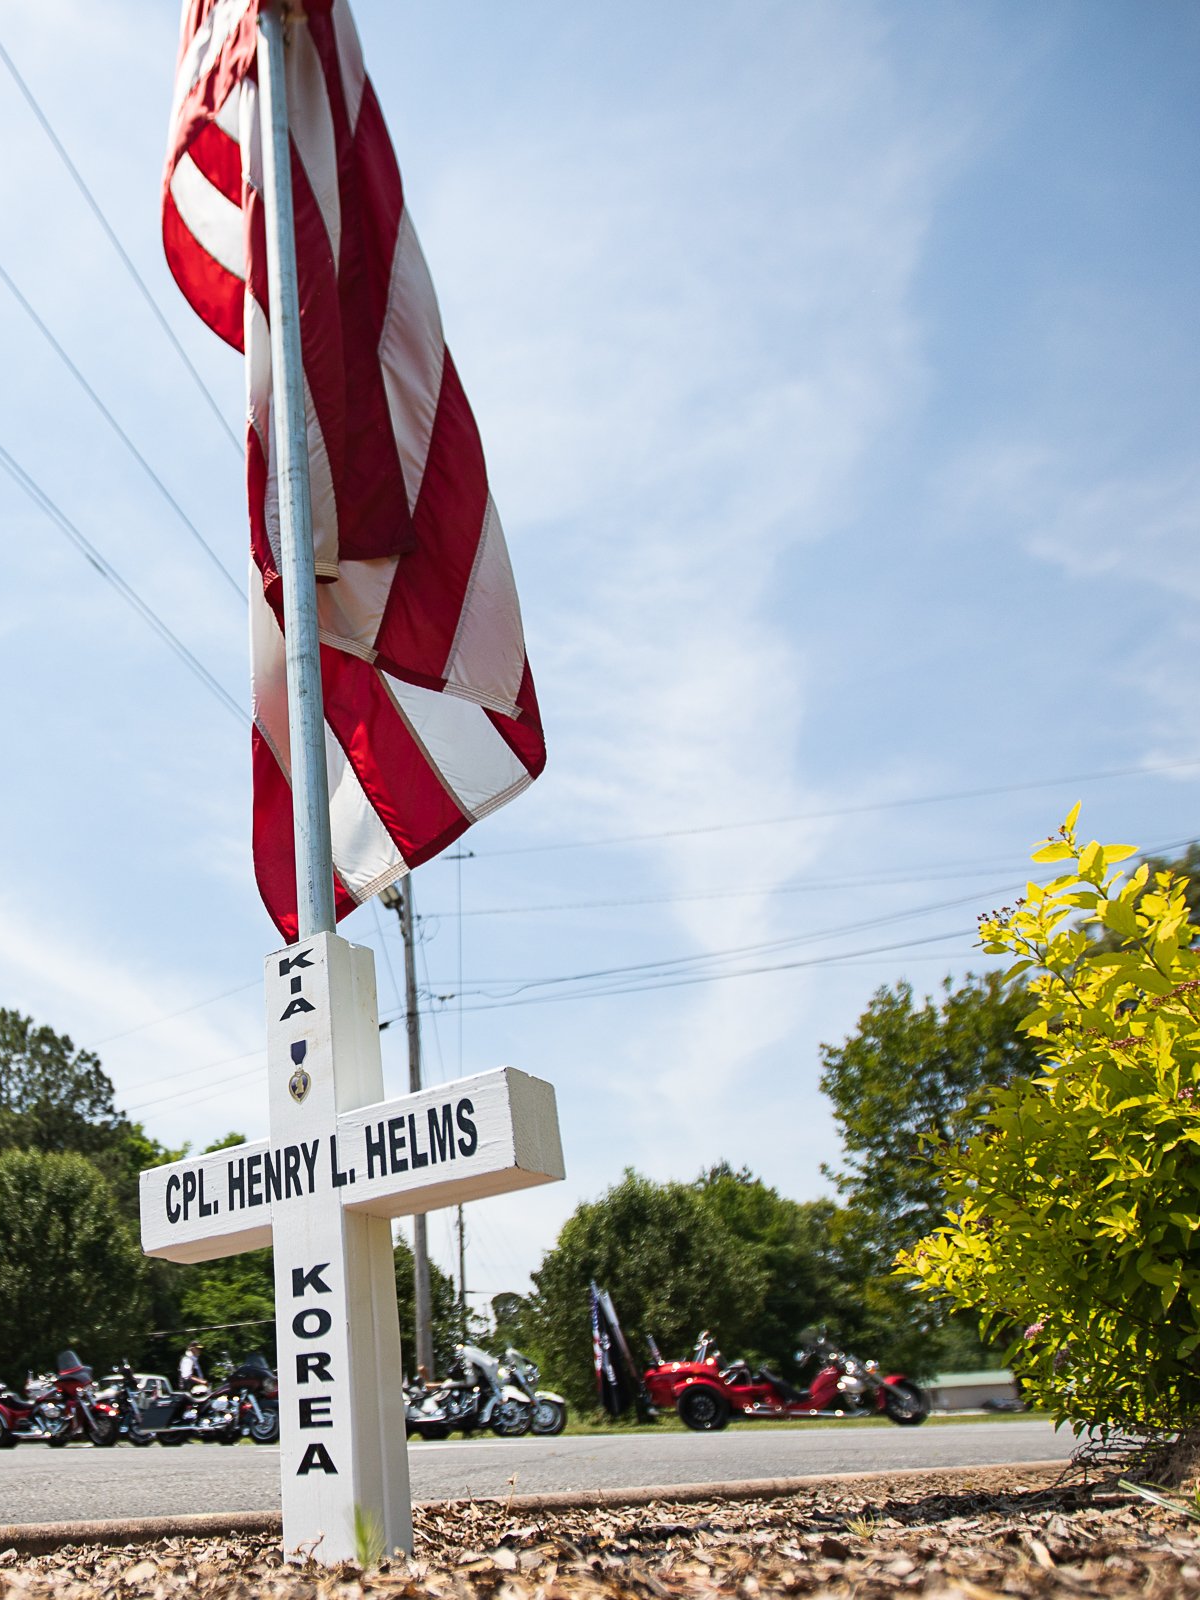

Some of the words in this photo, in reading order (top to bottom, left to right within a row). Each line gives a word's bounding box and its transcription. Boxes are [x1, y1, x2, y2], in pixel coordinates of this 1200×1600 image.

[278, 948, 316, 1022] KIA
[165, 1168, 219, 1224] CPL.
[227, 1138, 320, 1212] HENRY
[330, 1134, 356, 1189] L.
[365, 1098, 479, 1180] HELMS
[291, 1262, 339, 1476] KOREA
